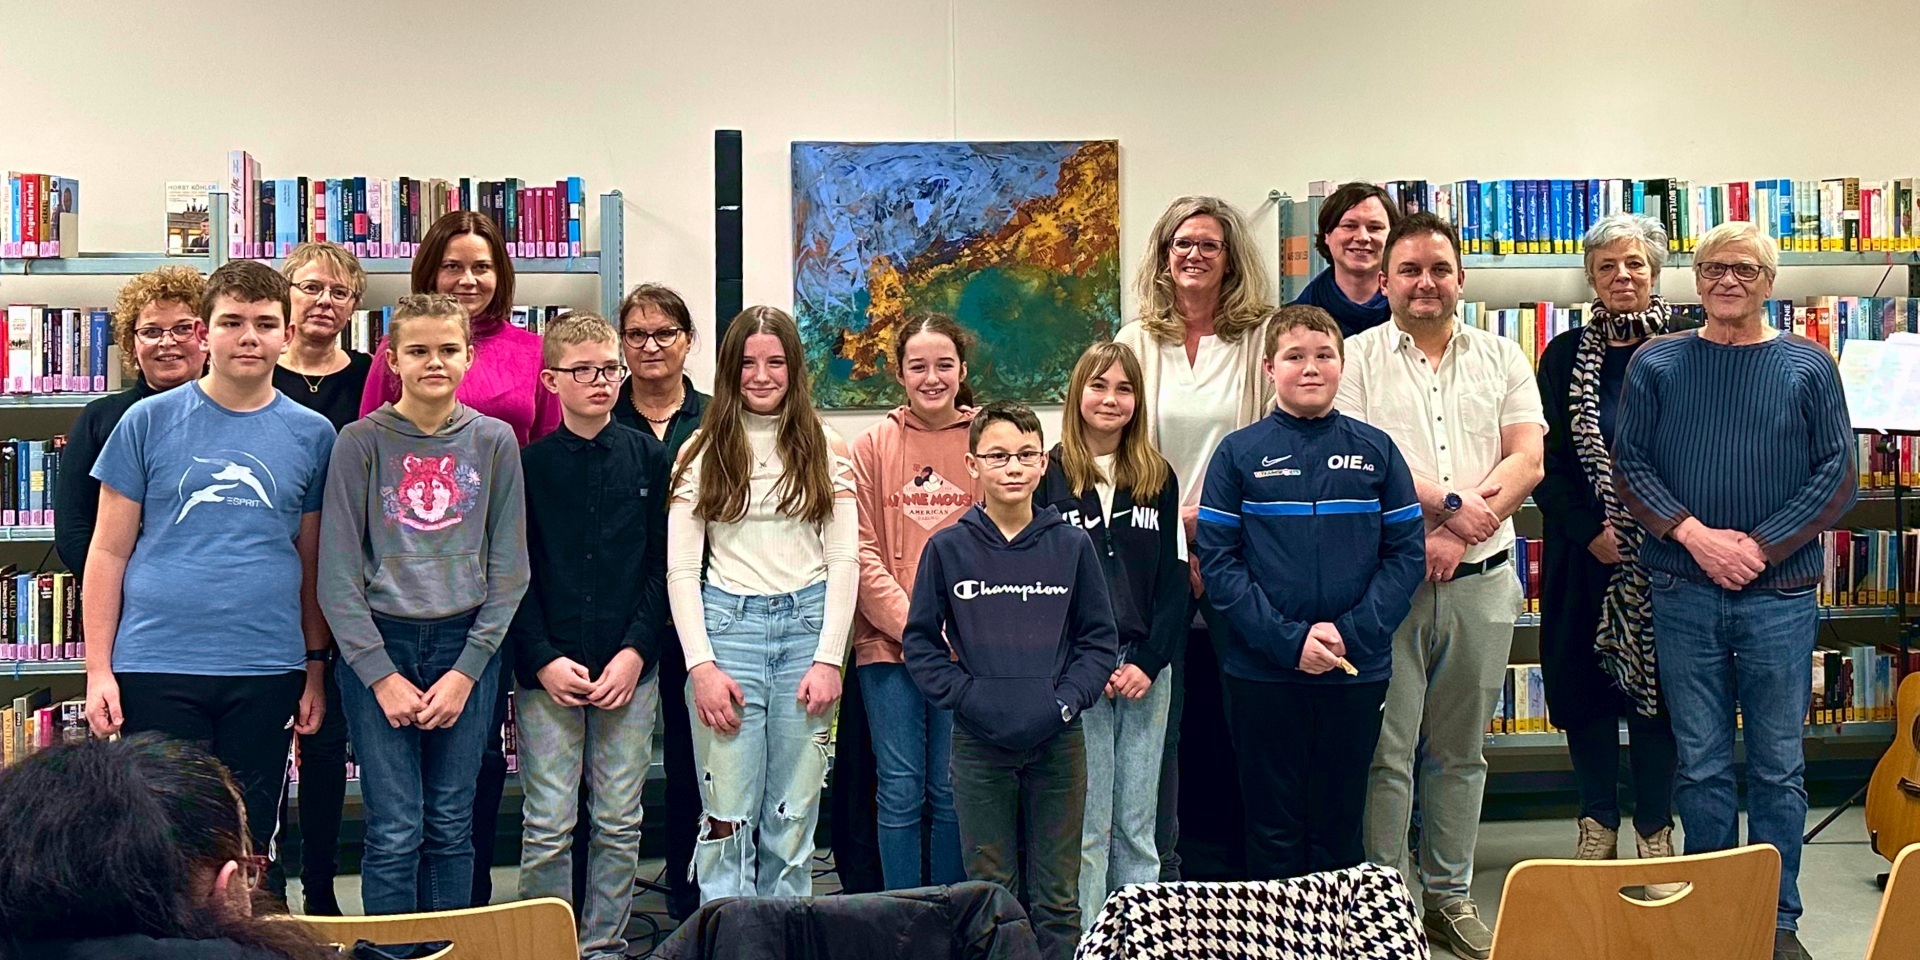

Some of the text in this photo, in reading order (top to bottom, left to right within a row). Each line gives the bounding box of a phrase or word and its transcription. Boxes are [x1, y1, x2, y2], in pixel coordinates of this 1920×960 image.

[26, 182, 35, 236] Angela Merkel
[1327, 454, 1374, 471] OIE AG
[226, 496, 260, 507] ESPRIT
[930, 493, 972, 506] MOUS
[1131, 506, 1159, 531] NIK
[953, 580, 1068, 602] Champion
